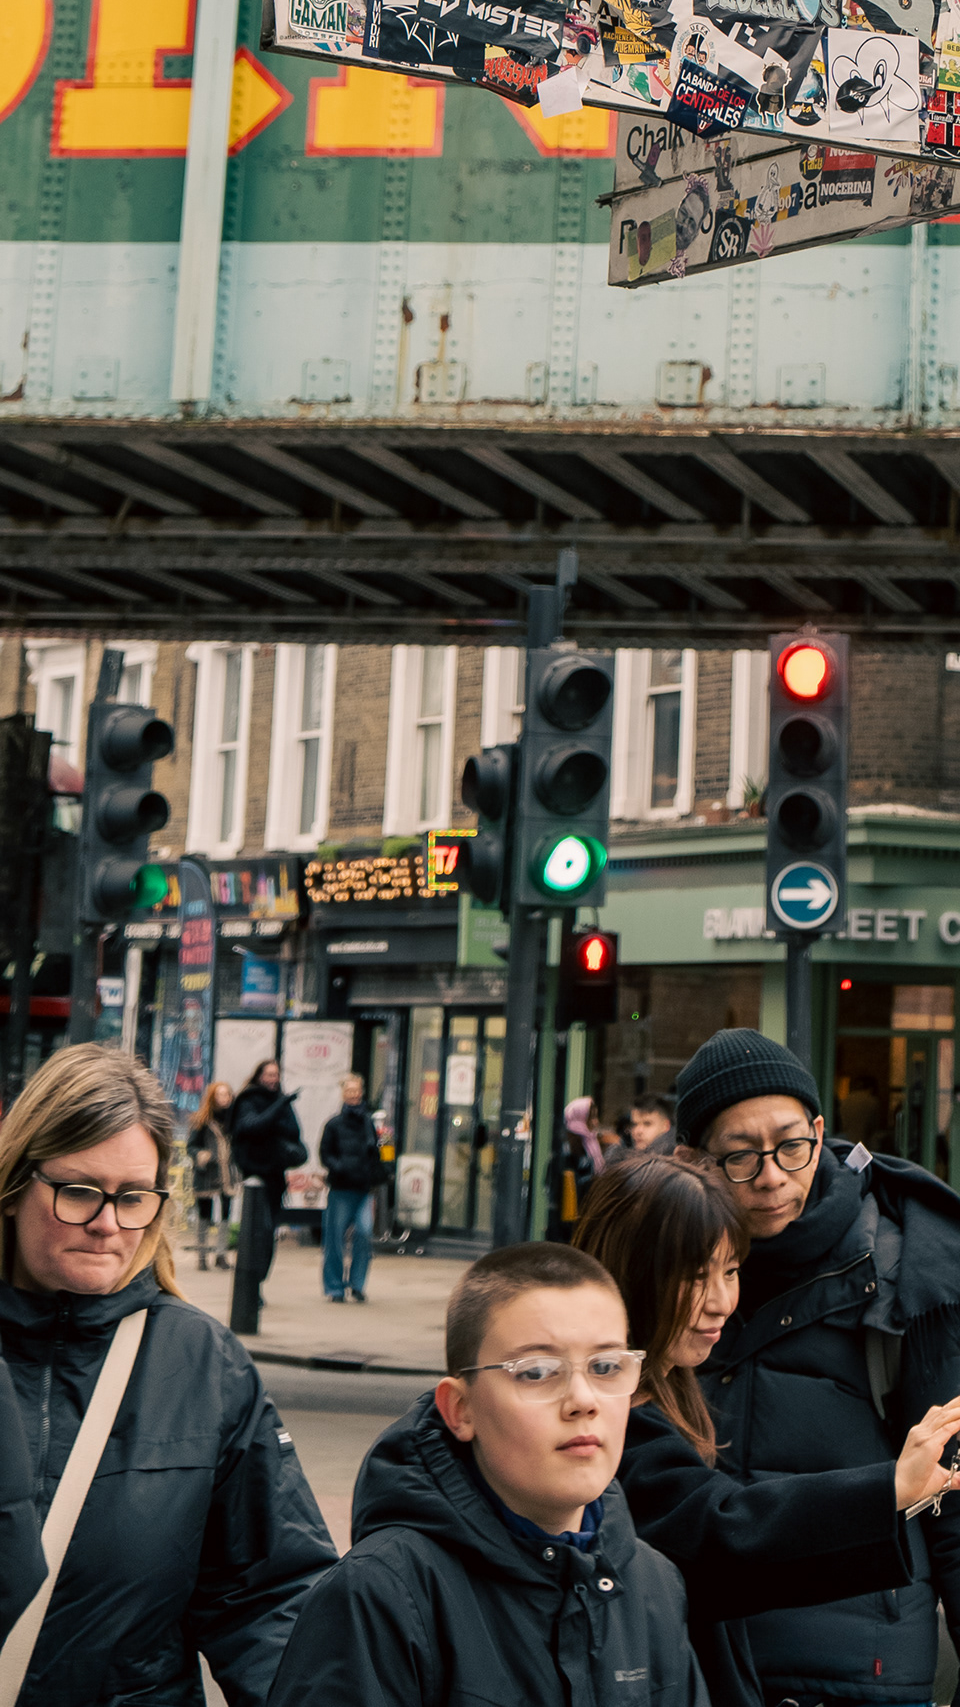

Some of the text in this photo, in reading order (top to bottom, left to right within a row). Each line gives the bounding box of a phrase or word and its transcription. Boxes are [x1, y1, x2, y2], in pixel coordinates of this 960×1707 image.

[689, 22, 709, 36] UEFA
[676, 82, 741, 129] CENTRALES
[681, 68, 746, 110] LA BANDA DE LOS
[626, 124, 687, 161] Chalk
[820, 180, 872, 196] NOCERINA
